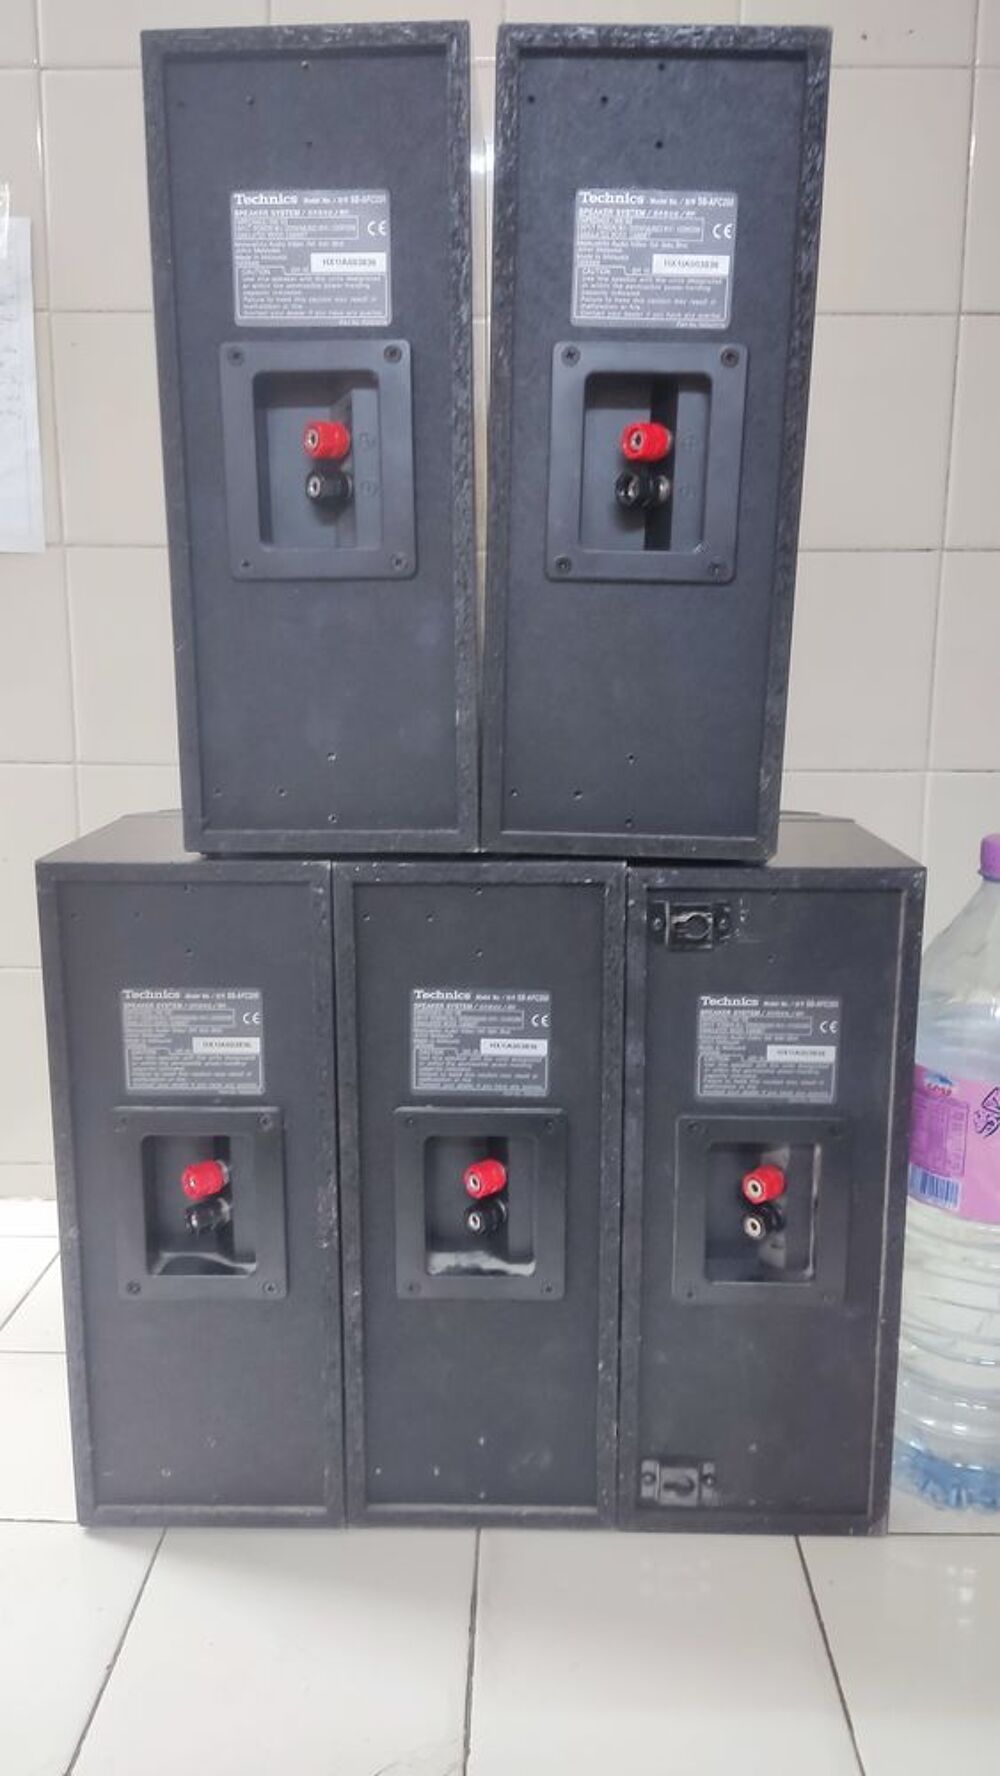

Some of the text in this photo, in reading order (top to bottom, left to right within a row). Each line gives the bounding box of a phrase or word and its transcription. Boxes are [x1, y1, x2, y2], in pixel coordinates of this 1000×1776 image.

[234, 193, 297, 205] Technics
[579, 191, 643, 205] Technics
[368, 221, 386, 236] CE
[712, 224, 734, 239] CE
[122, 990, 180, 999] Technics
[413, 989, 472, 1000] Technics
[700, 996, 759, 1006] Technics
[243, 1012, 261, 1024] CE
[531, 1014, 550, 1028] CE
[819, 1020, 839, 1034] CE
